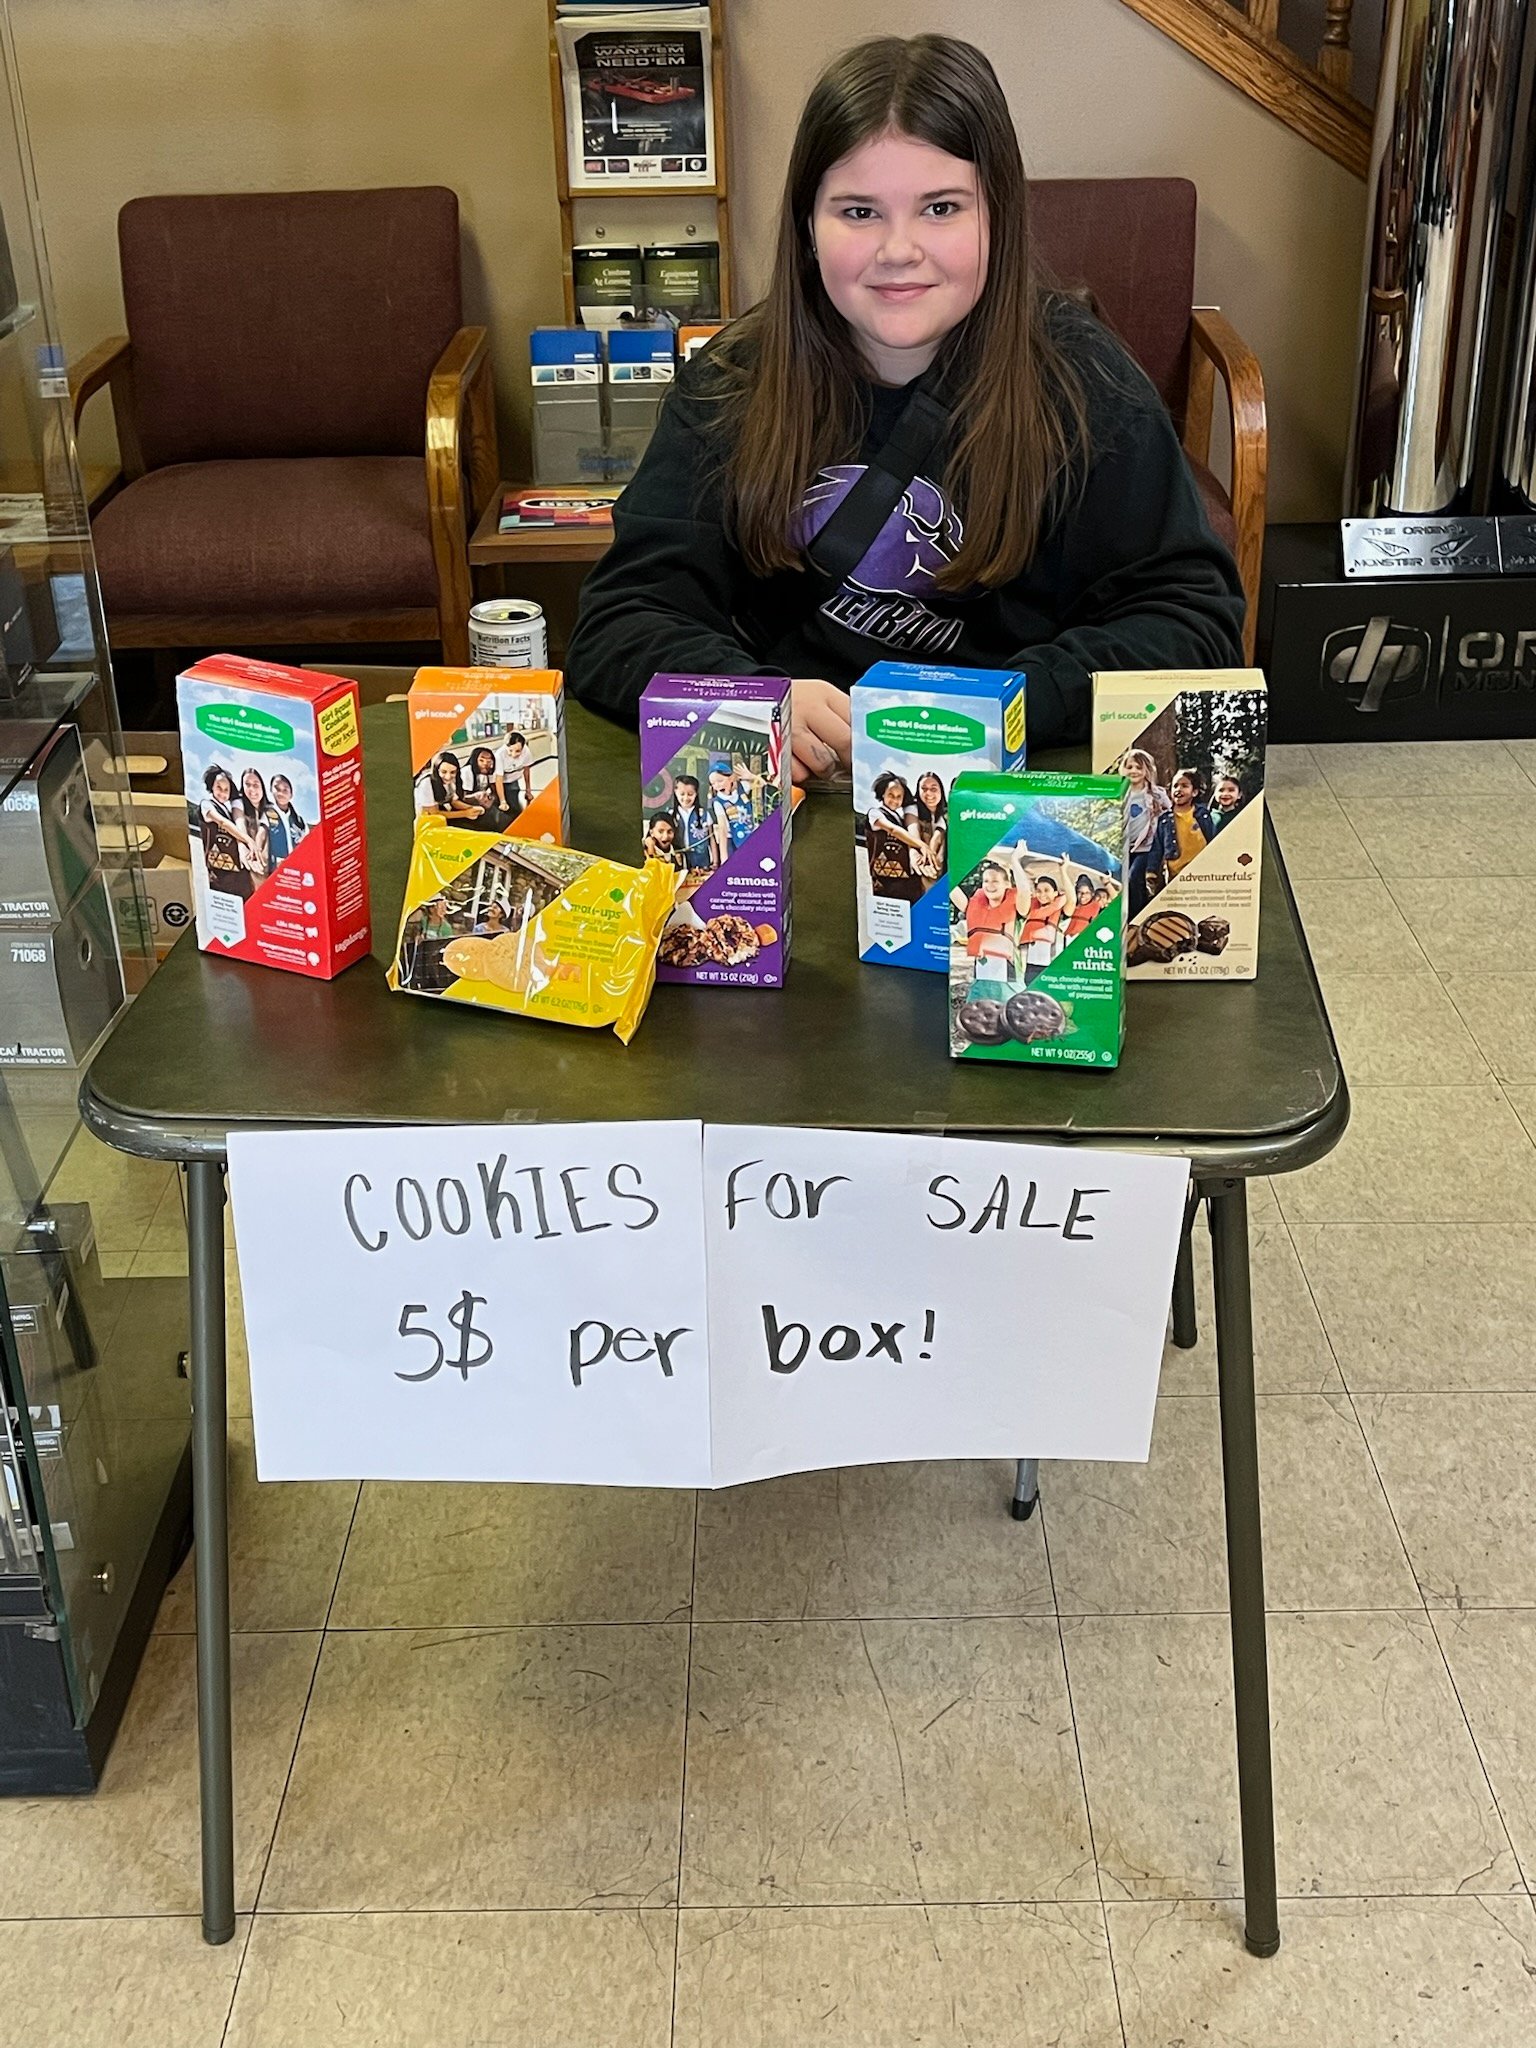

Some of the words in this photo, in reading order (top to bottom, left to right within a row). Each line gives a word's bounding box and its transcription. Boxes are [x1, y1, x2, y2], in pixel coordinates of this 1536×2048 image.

[478, 634, 509, 645] Nutrition
[511, 635, 530, 644] Facts
[415, 709, 430, 720] girl
[430, 711, 458, 719] scouts
[1100, 711, 1115, 722] girl
[1118, 712, 1147, 720] scouts
[647, 717, 663, 728] girl
[663, 719, 691, 728] scouts
[882, 719, 896, 727] The
[897, 720, 912, 728] Girl
[914, 722, 936, 731] Scout
[937, 724, 968, 733] Mission
[960, 811, 976, 821] girl
[977, 812, 1007, 820] scouts
[1180, 872, 1252, 882] adventurefuls
[721, 891, 738, 899] Crisp
[2, 902, 49, 911] TRACTOR
[10, 949, 46, 962] 71068
[1084, 946, 1113, 959] thin
[1163, 966, 1176, 975] NET
[1177, 966, 1188, 975] WT
[1200, 966, 1209, 974] OZ
[696, 971, 708, 981] NET
[709, 972, 719, 981] WT
[730, 972, 738, 982] OZ
[1041, 975, 1057, 984] Crisp,
[1059, 976, 1088, 985] chocolaty
[1090, 977, 1113, 985] cookies
[1076, 992, 1113, 1001] peppermint
[20, 1047, 65, 1057] TRACTOR
[1031, 1047, 1044, 1057] NET
[1045, 1048, 1057, 1058] WT
[1057, 1048, 1062, 1058] 9
[344, 1153, 659, 1252] COOKIES
[926, 1174, 1111, 1240] SALE
[394, 1290, 493, 1382] 5$
[569, 1320, 694, 1387] per
[761, 1304, 935, 1374] box!
